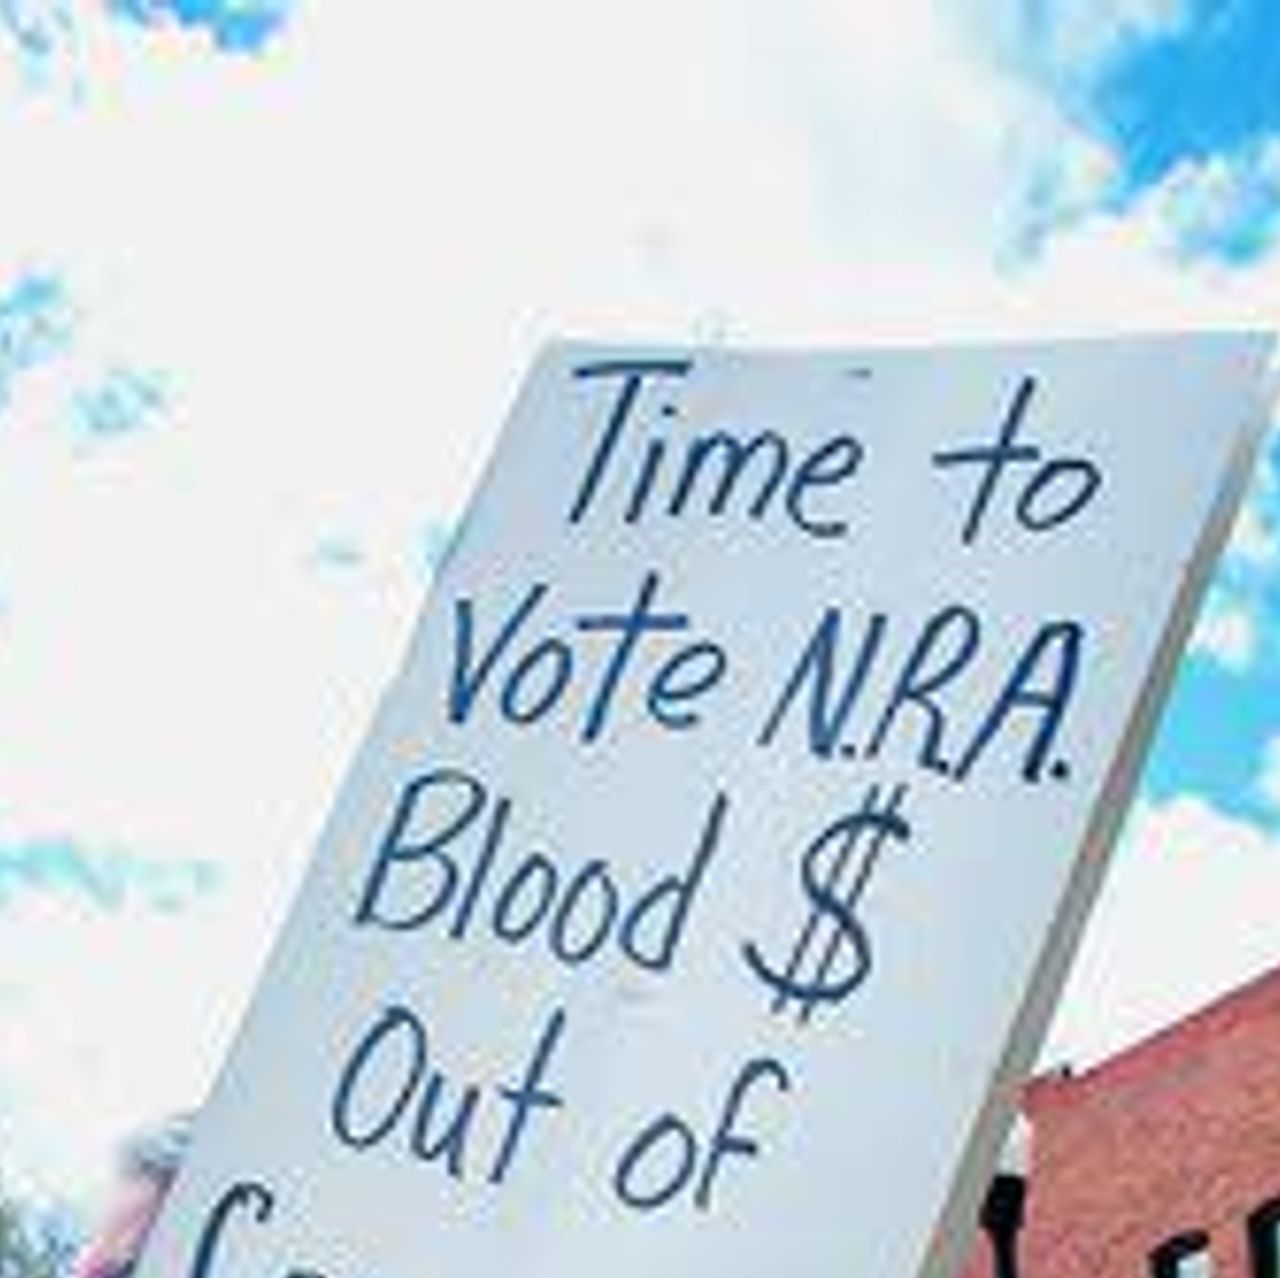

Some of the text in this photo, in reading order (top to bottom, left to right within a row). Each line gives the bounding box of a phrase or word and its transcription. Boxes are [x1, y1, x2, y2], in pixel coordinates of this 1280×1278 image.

[569, 360, 1102, 545] Time to
[448, 571, 726, 743] Vote
[354, 770, 910, 1022] Blood $
[333, 1006, 789, 1209] Out of
